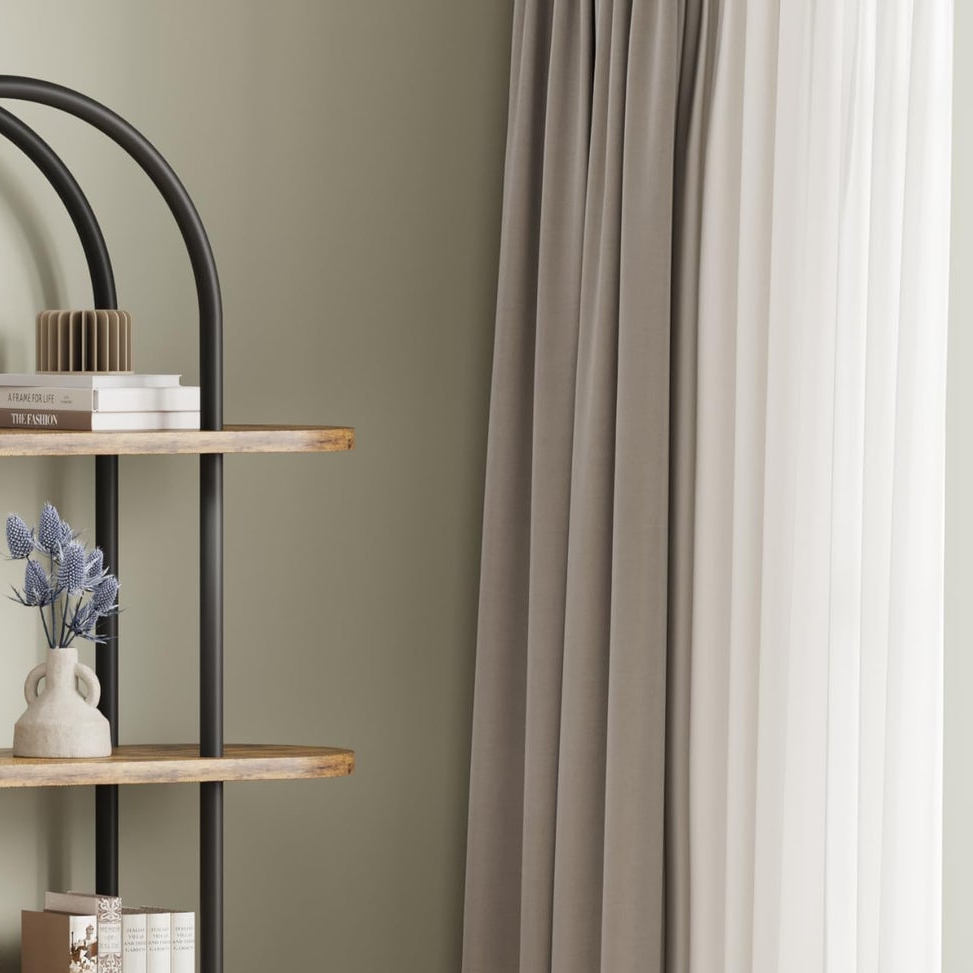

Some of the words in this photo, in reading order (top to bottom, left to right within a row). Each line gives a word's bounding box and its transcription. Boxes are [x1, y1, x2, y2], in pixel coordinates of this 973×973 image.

[12, 392, 31, 403] FRAME
[31, 393, 43, 404] FOR
[43, 393, 55, 404] LIFE
[10, 413, 27, 425] THE
[27, 413, 58, 426] FASHION
